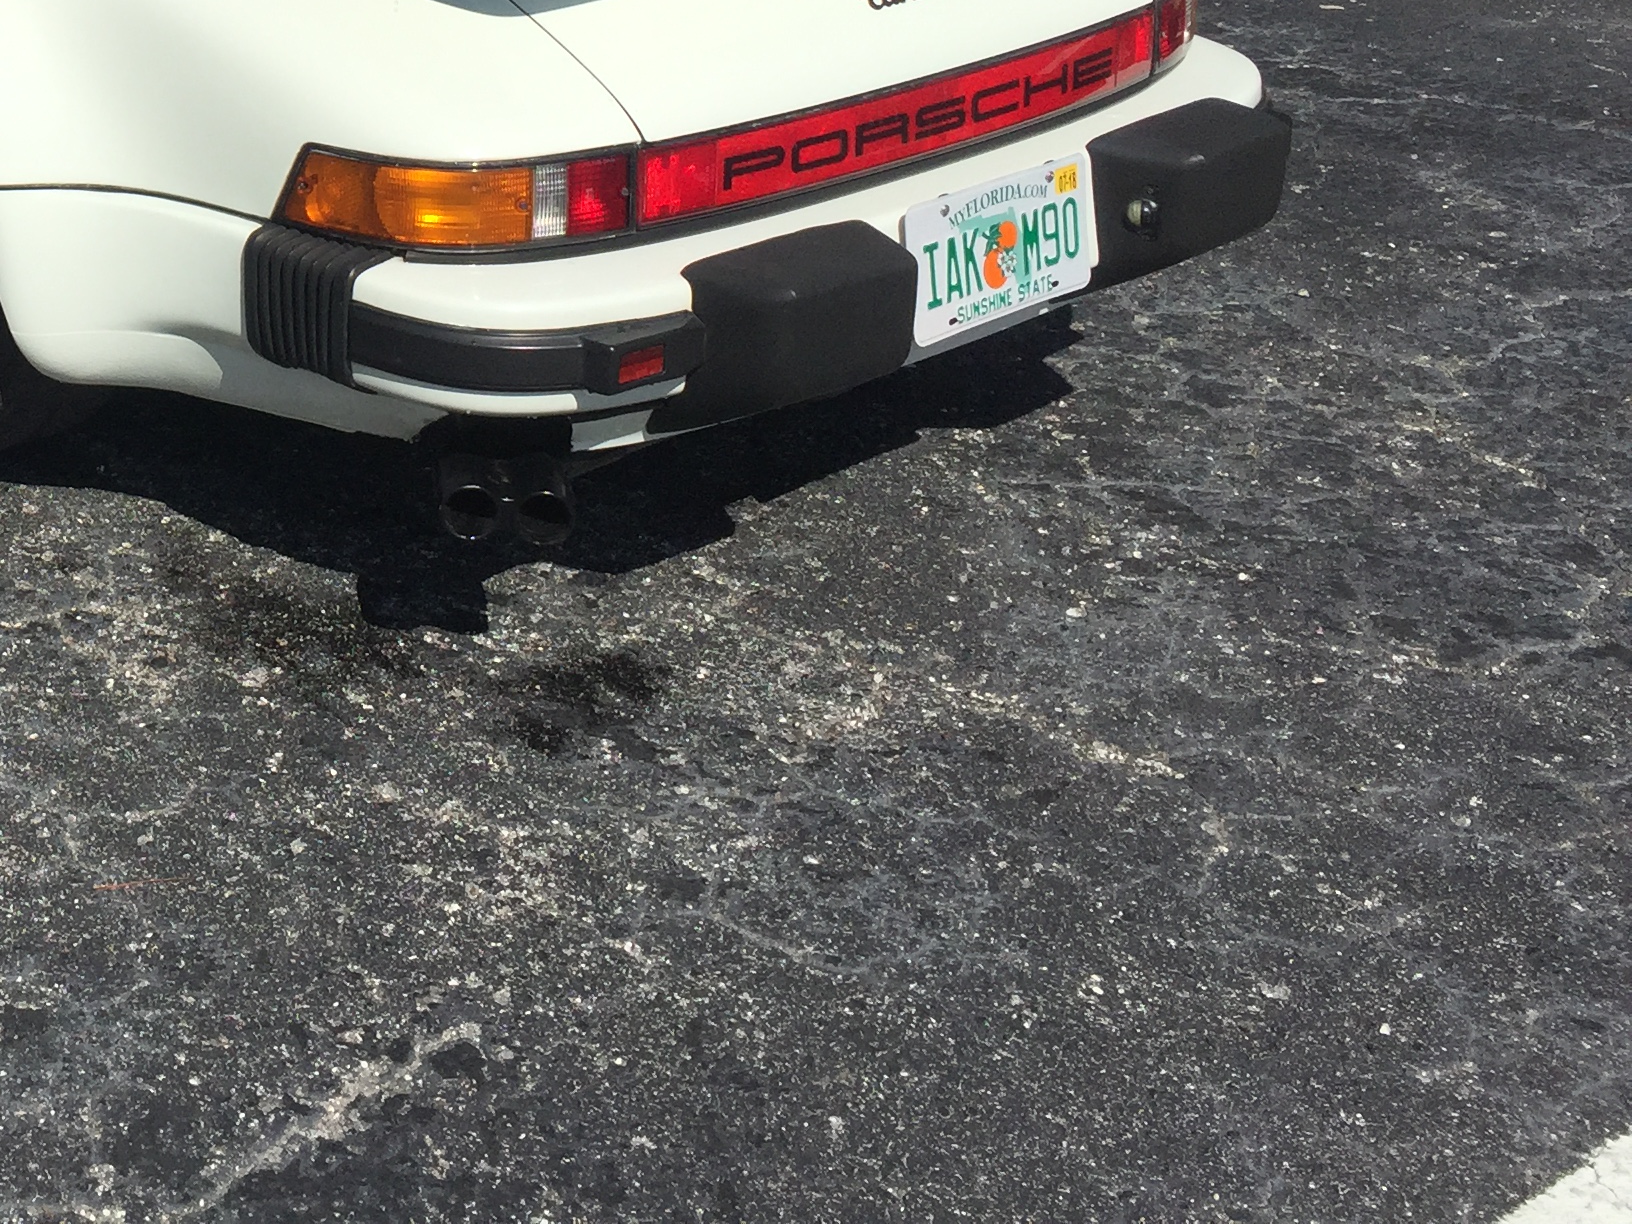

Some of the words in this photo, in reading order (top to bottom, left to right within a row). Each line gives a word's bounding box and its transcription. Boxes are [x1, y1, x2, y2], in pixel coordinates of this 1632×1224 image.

[722, 48, 1114, 190] PORSCHE
[947, 183, 1049, 230] MYFLORIDA.COM
[1020, 196, 1080, 277] M90
[956, 288, 1013, 325] SUNSHINE
[1017, 274, 1054, 302] STATE
